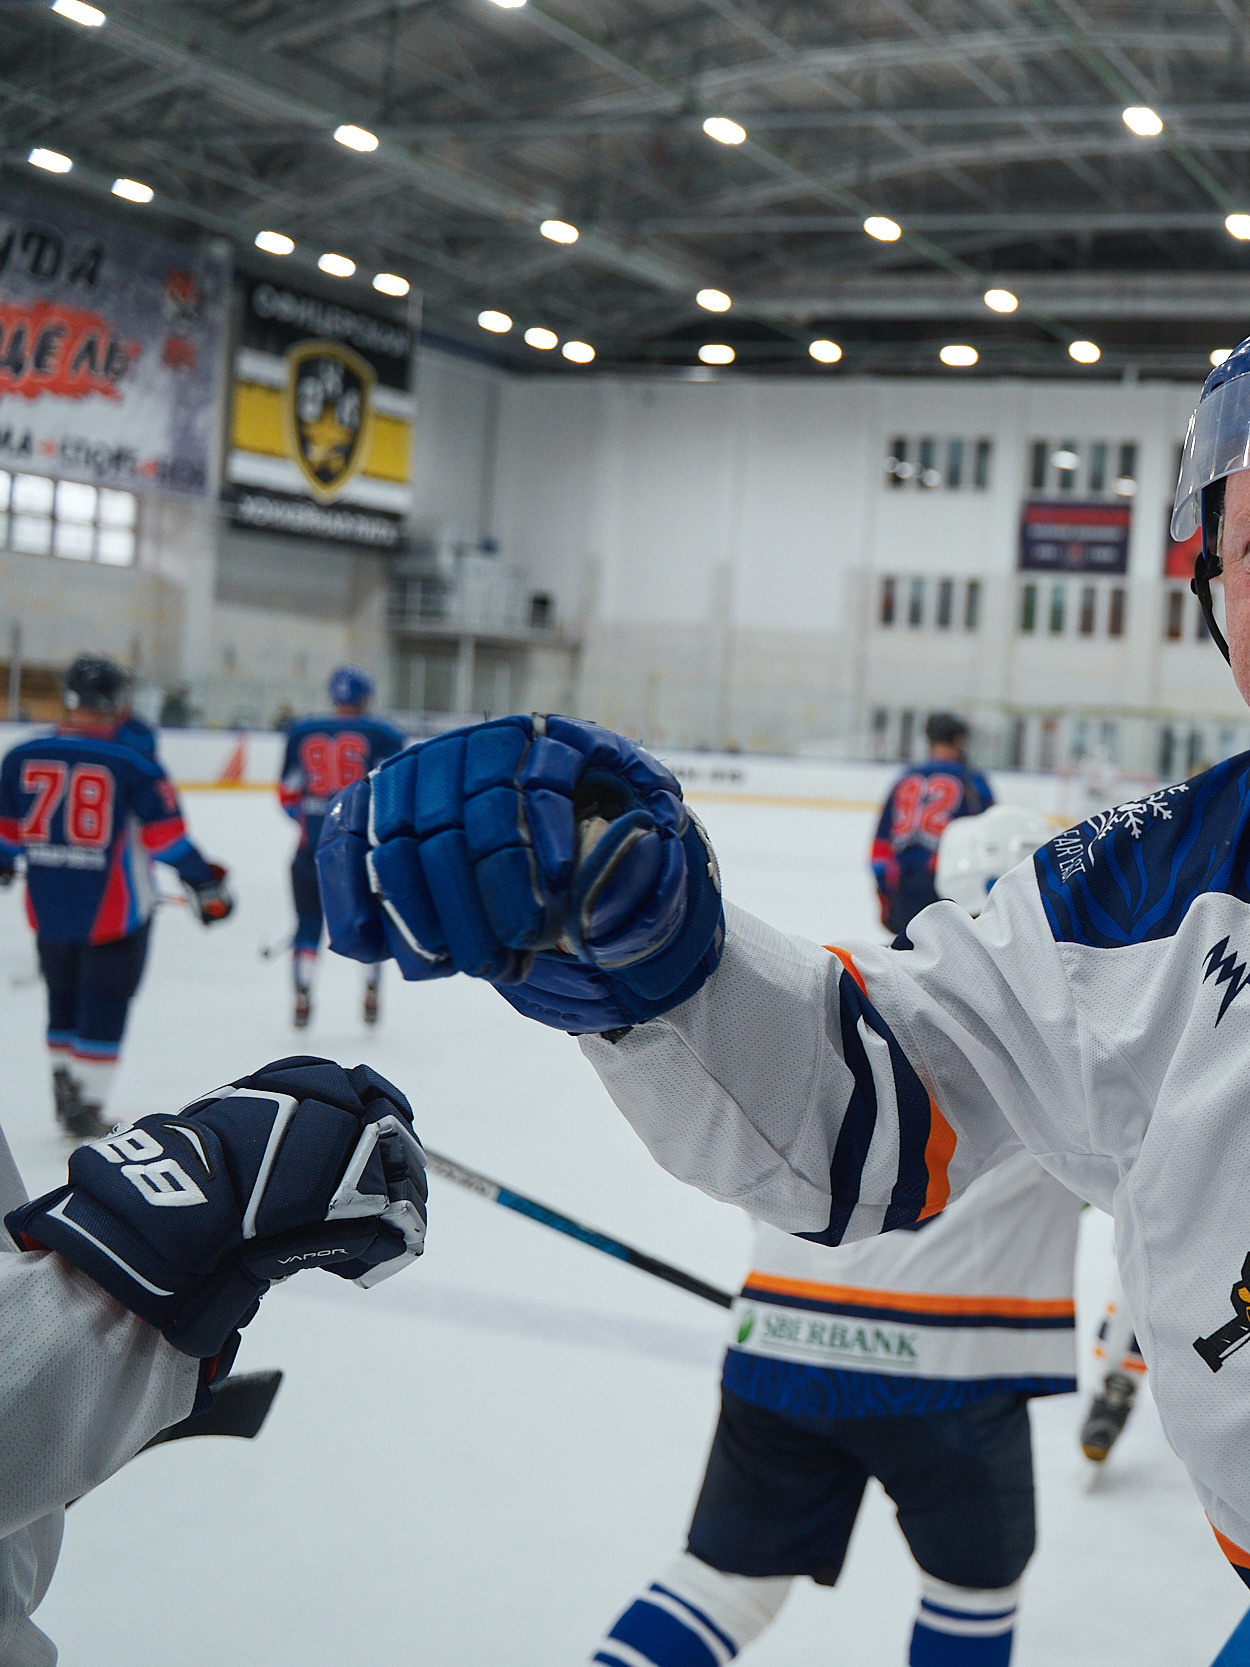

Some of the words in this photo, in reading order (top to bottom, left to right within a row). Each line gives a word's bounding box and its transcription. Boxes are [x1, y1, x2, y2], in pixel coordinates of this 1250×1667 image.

[299, 731, 370, 797] 96
[19, 758, 116, 849] 78
[891, 773, 964, 837] 92
[277, 1247, 350, 1265] VAPOR
[760, 1314, 919, 1358] SBERBANK
